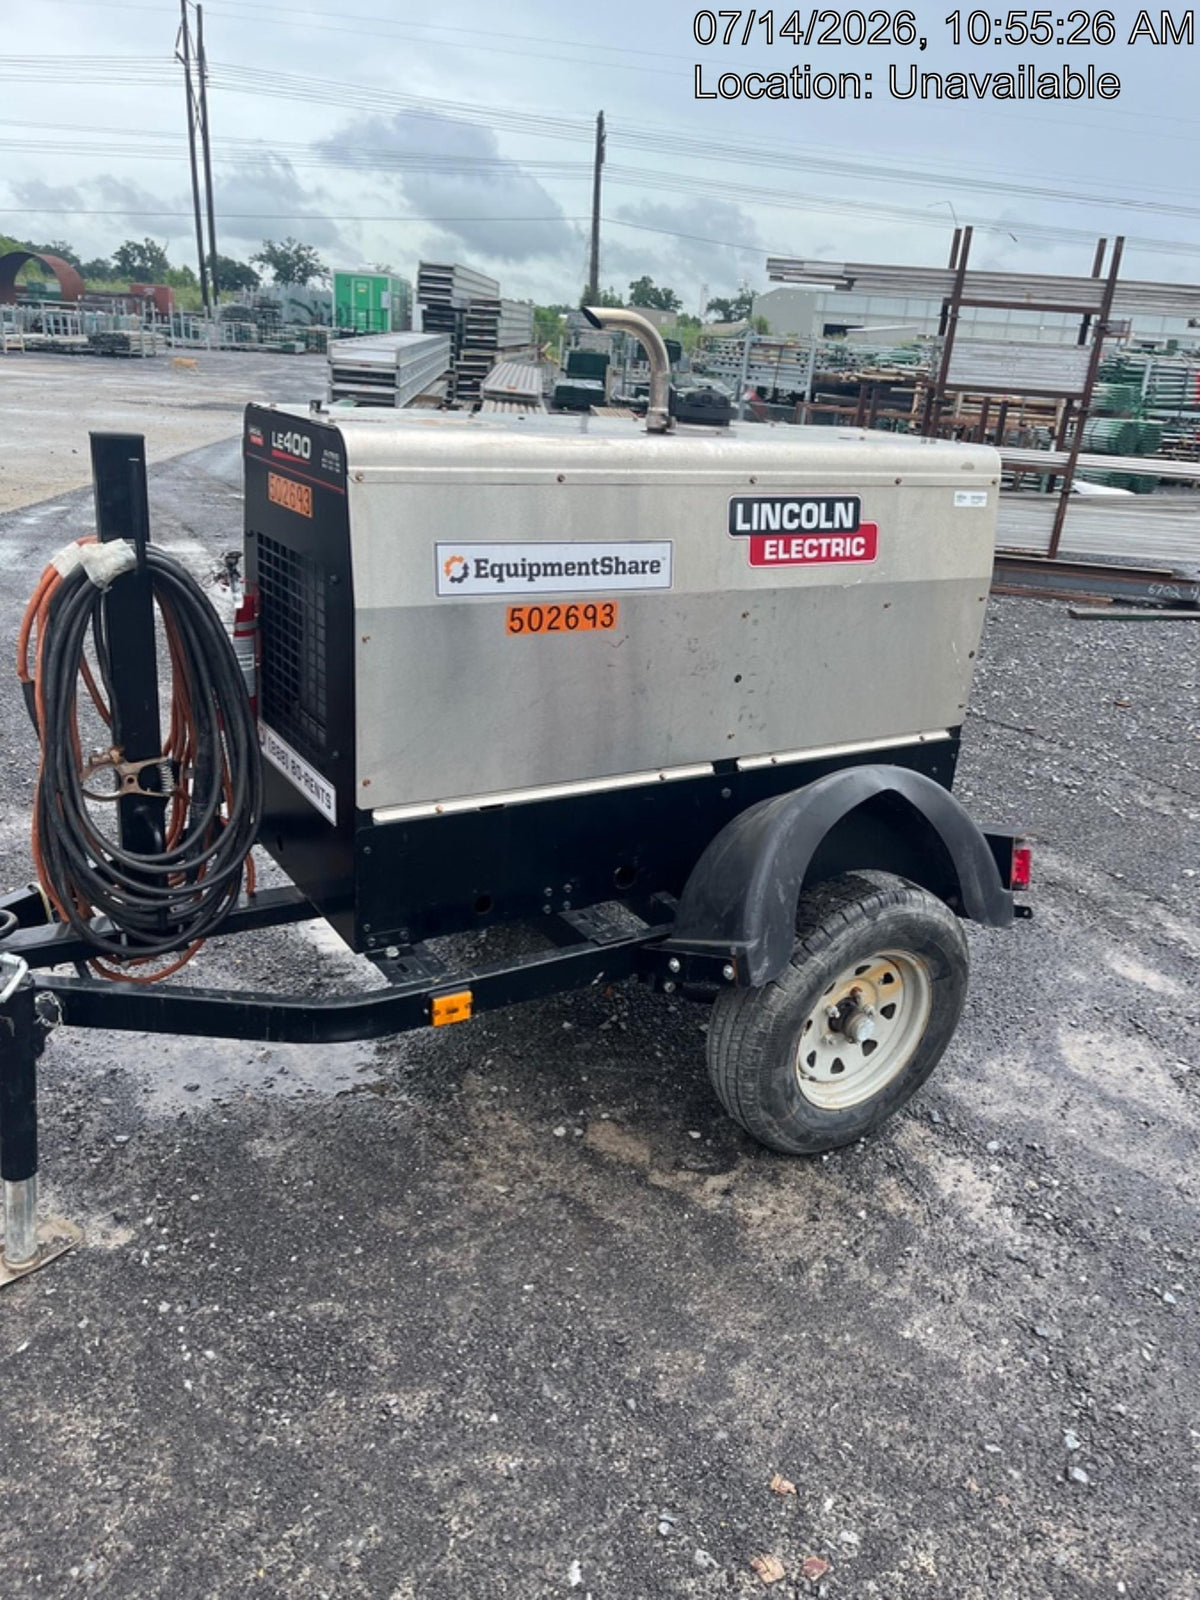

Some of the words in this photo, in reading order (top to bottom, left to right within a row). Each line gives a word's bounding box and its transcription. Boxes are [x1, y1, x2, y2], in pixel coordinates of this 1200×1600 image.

[271, 431, 312, 459] LE400
[269, 474, 311, 515] 502693
[735, 502, 855, 531] LINCOLN
[764, 537, 866, 560] ELECTRIC
[473, 556, 661, 583] EquipmentShare
[508, 602, 616, 634] 502693
